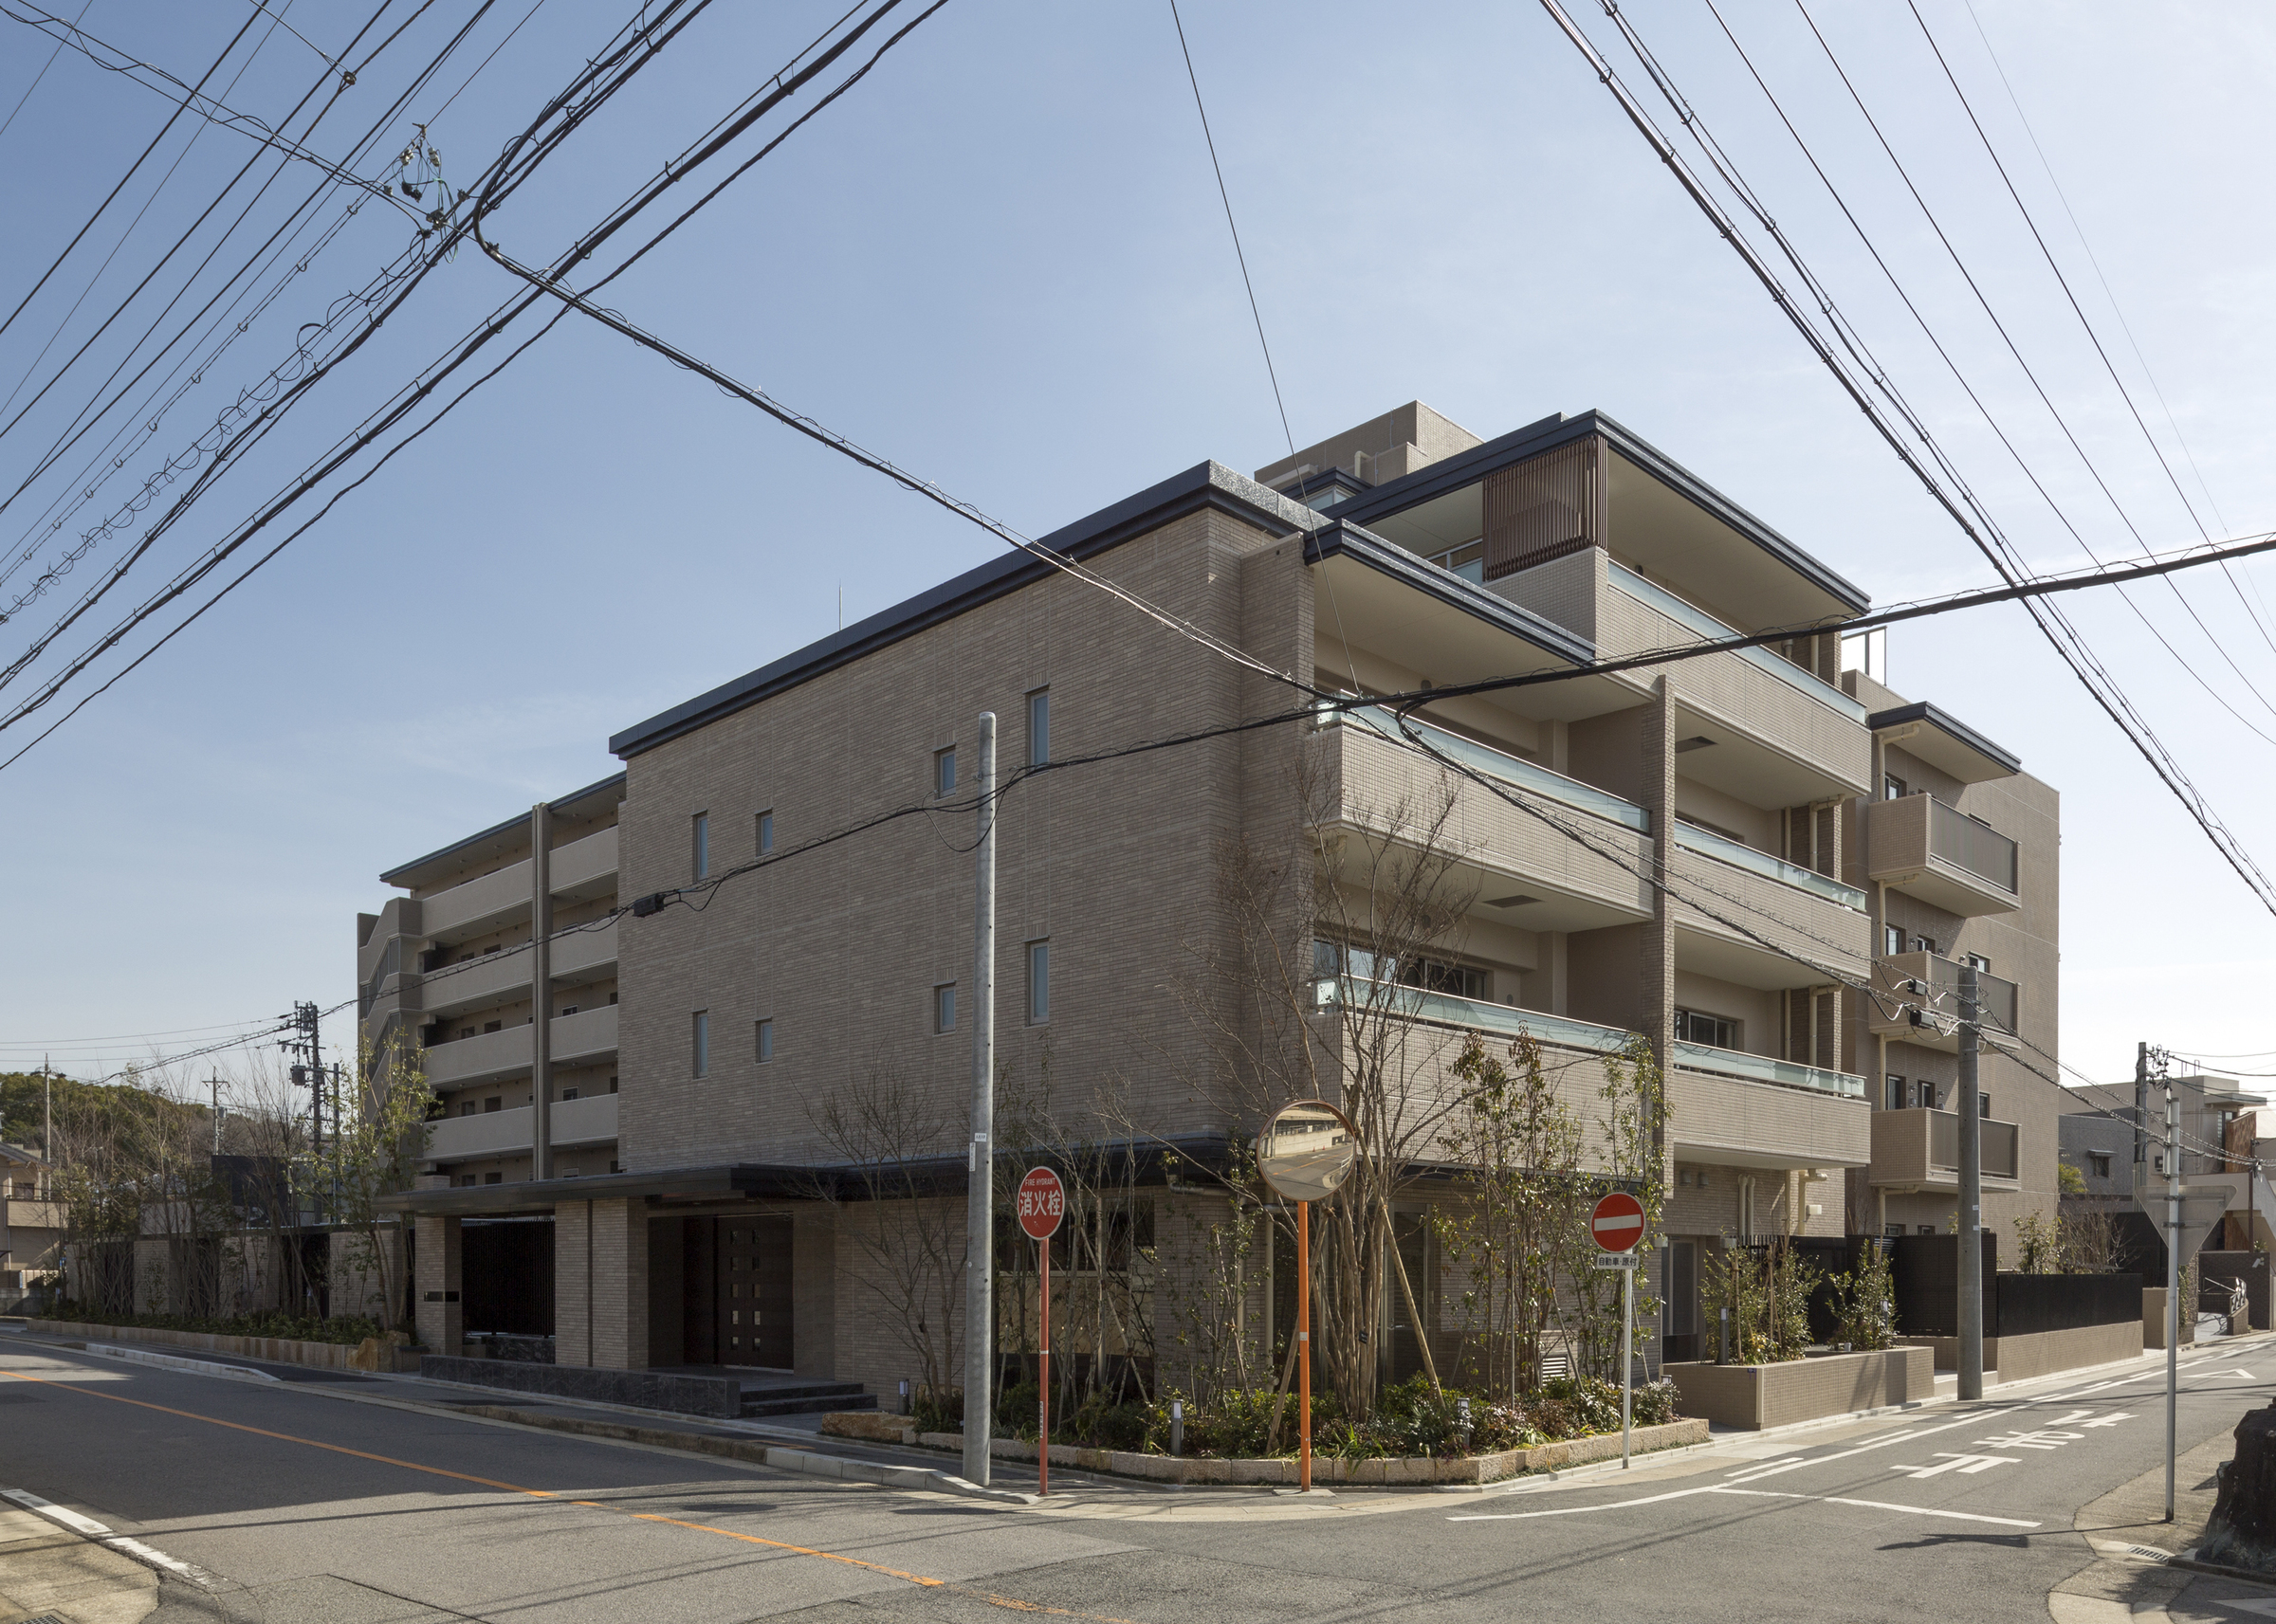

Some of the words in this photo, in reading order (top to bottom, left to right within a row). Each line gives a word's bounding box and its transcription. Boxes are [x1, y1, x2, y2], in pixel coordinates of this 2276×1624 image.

[1036, 1177, 1055, 1186] HYDRANT
[1019, 1190, 1061, 1216] 消火栓
[1599, 1257, 1637, 1266] 自動車・原付
[1889, 1410, 2139, 1478] 止まれ
